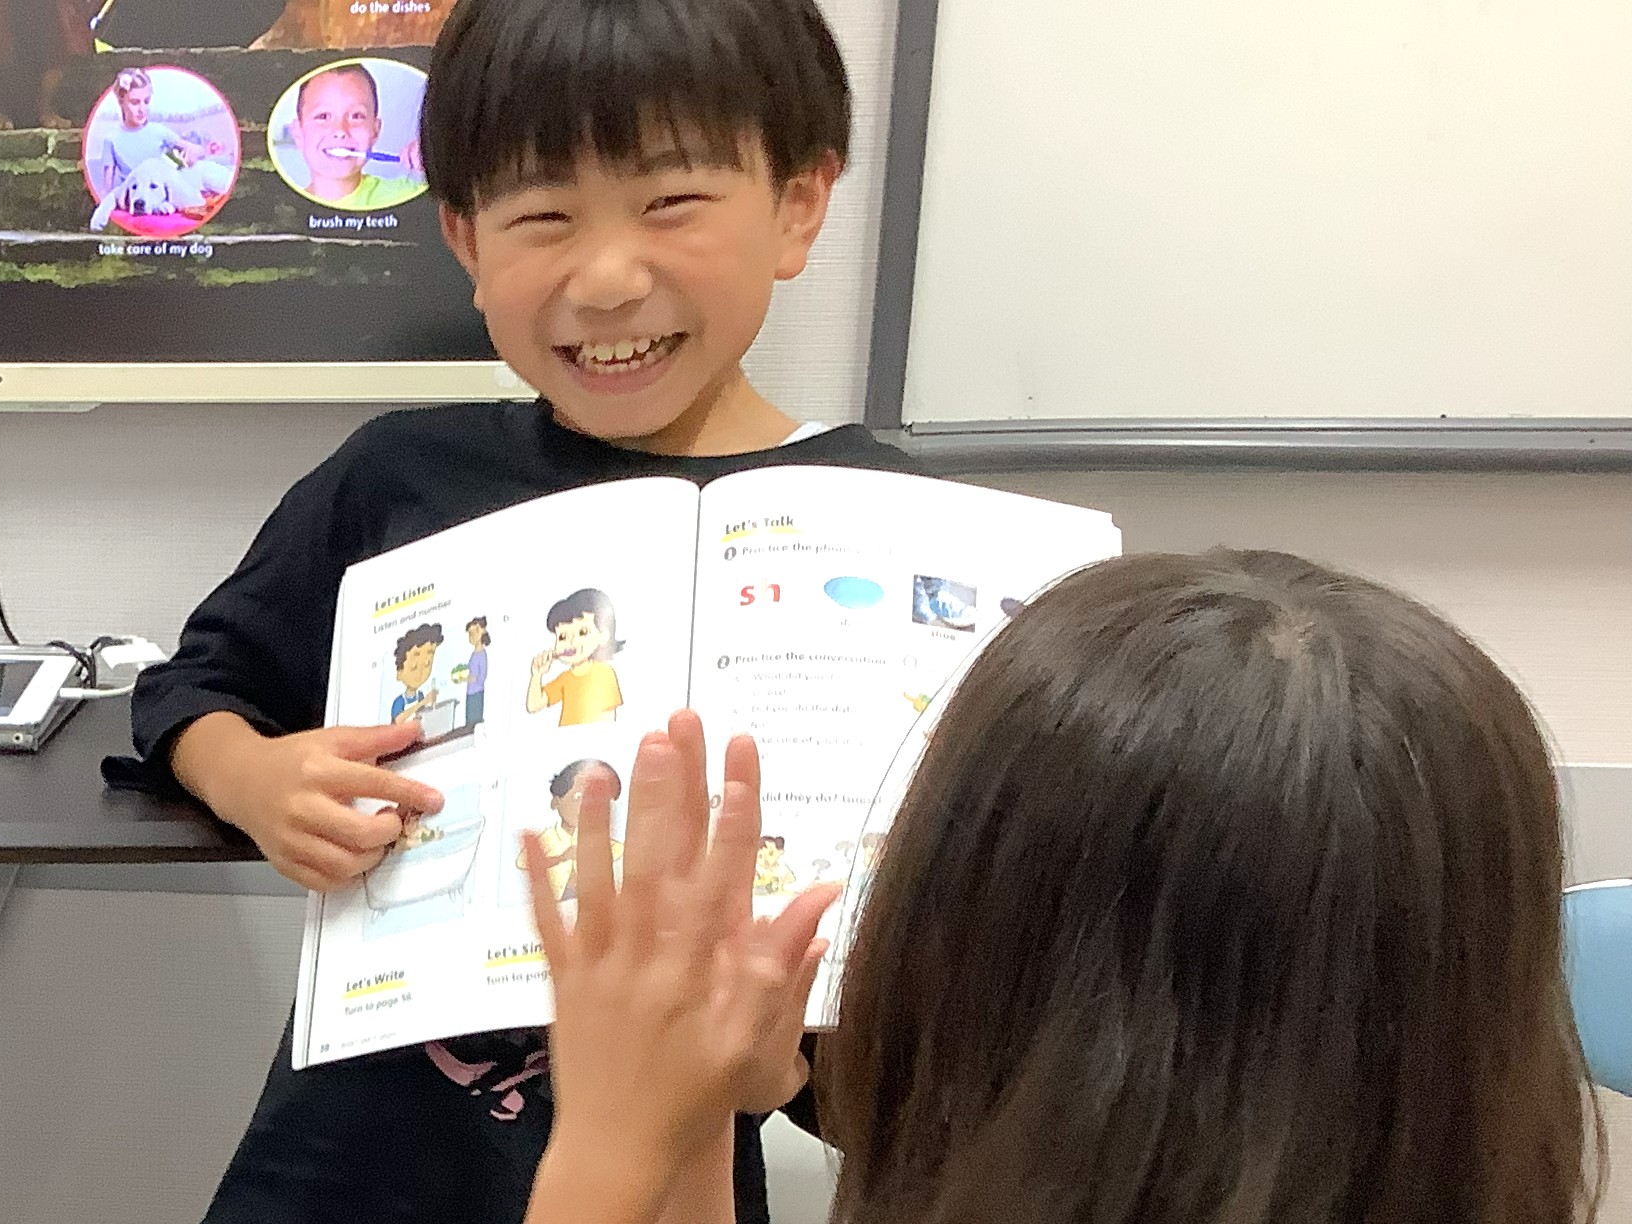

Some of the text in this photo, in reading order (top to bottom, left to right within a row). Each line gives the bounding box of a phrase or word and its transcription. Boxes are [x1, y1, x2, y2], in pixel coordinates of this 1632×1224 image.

[350, 0, 430, 14] do the dishes
[308, 215, 398, 230] brush my teeth
[99, 243, 214, 257] take care of my dog
[725, 515, 794, 536] Let's Talk
[374, 582, 435, 612] Let's Listen
[373, 618, 398, 634] Listen
[399, 610, 417, 625] and
[785, 792, 812, 804] they
[487, 942, 546, 961] Let's Sin
[345, 969, 405, 993] Let's Write
[525, 969, 549, 984] pag
[365, 1001, 374, 1012] to
[376, 997, 399, 1012] page
